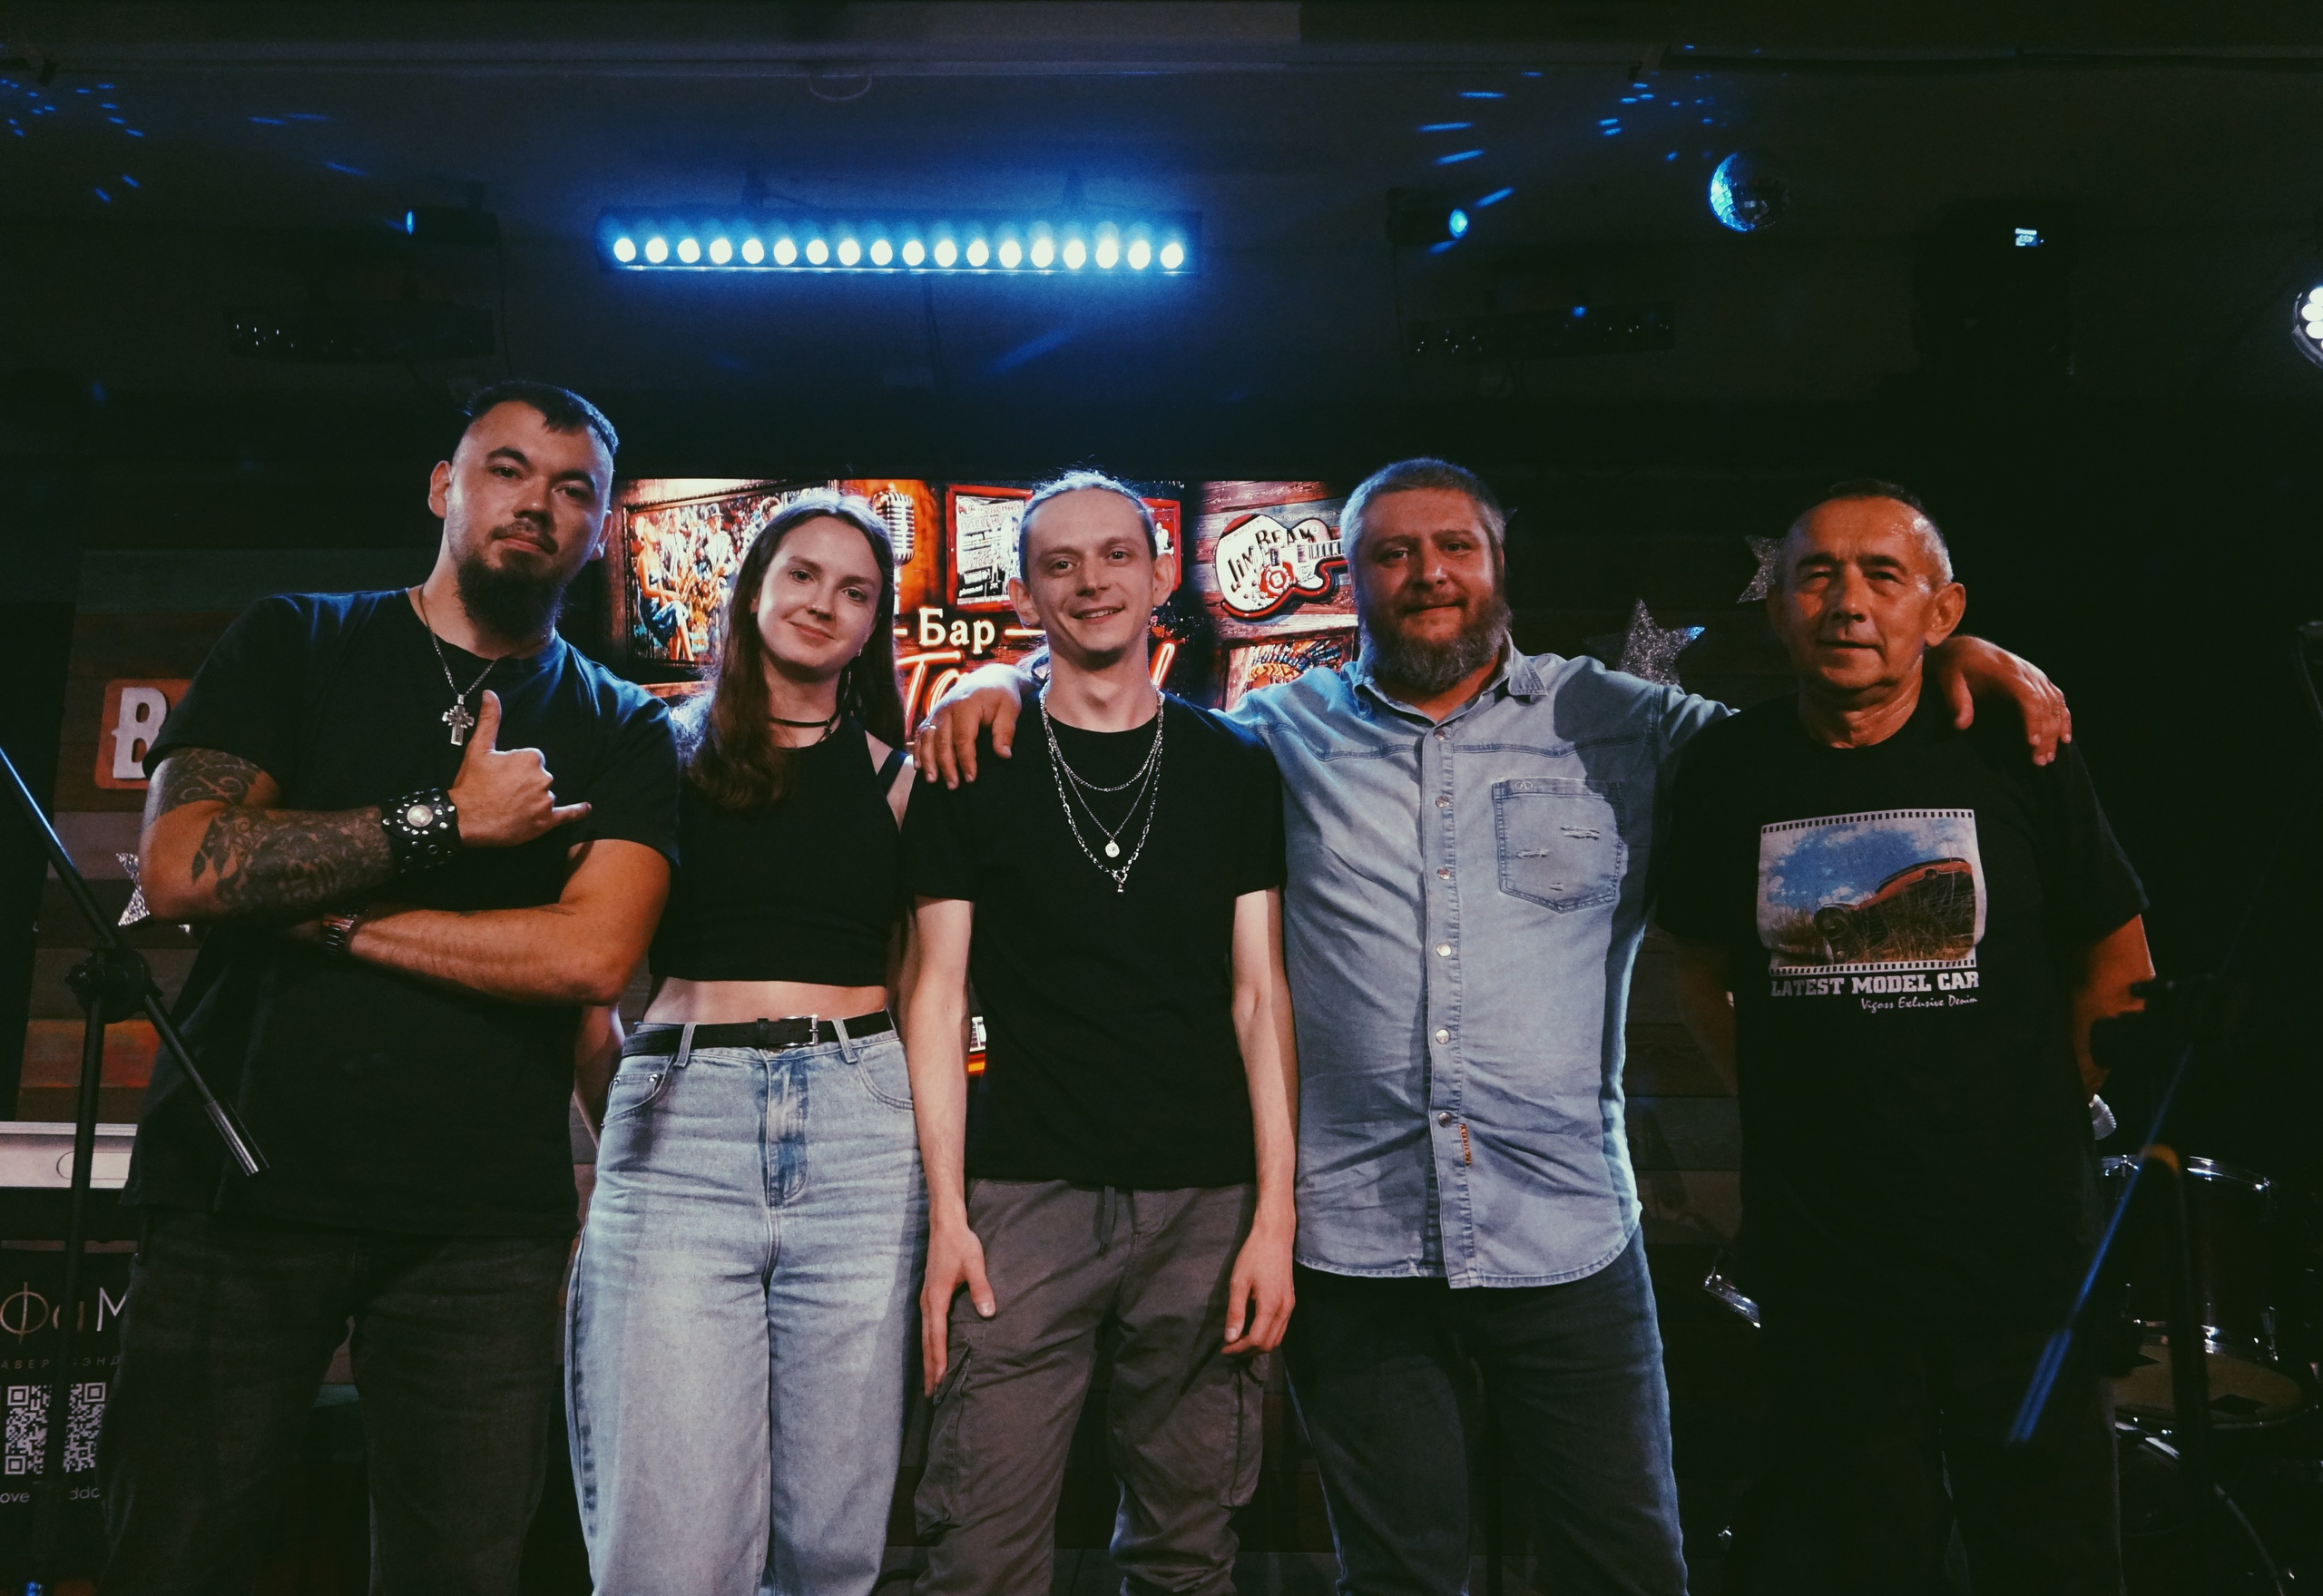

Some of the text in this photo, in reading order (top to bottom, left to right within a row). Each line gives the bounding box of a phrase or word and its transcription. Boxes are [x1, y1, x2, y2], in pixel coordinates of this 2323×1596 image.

[1227, 544, 1255, 592] JIM
[1255, 527, 1316, 554] BEAM
[918, 607, 995, 655] Бар
[1771, 971, 1980, 997] LATEST MODEL CAR
[1948, 994, 1978, 1007] Denim
